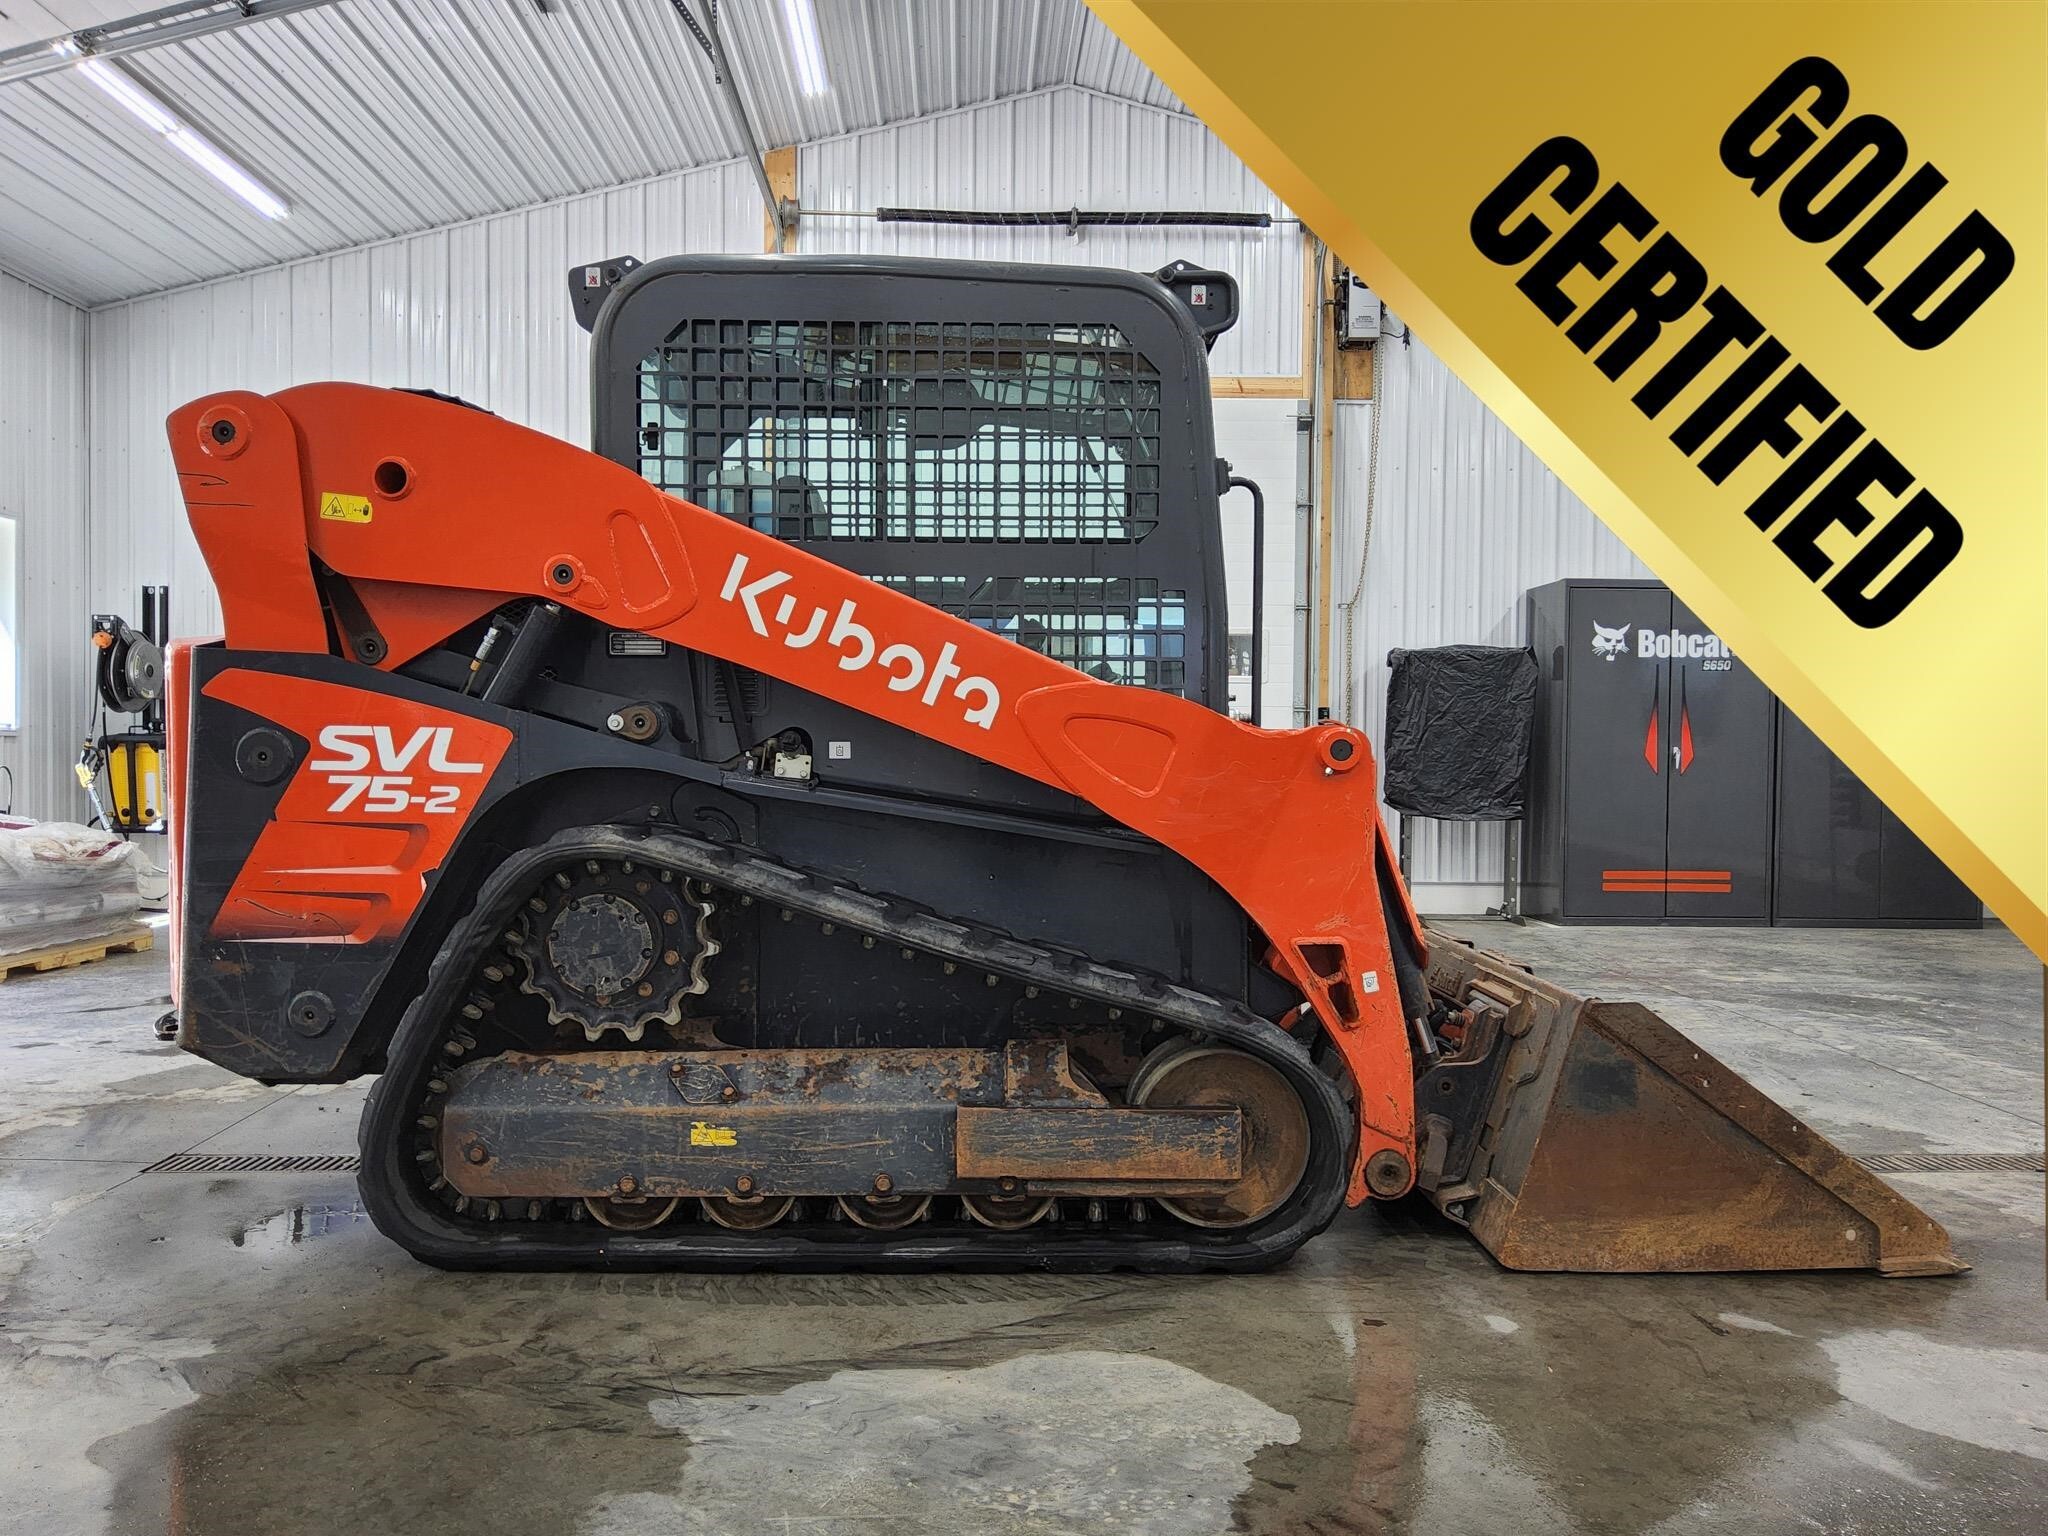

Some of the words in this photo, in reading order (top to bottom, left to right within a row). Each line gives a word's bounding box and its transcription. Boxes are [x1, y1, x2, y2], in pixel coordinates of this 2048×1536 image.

[719, 553, 1001, 730] Kubota
[1702, 660, 1732, 671] S650
[309, 725, 485, 773] SVL
[326, 775, 461, 813] 75-2
